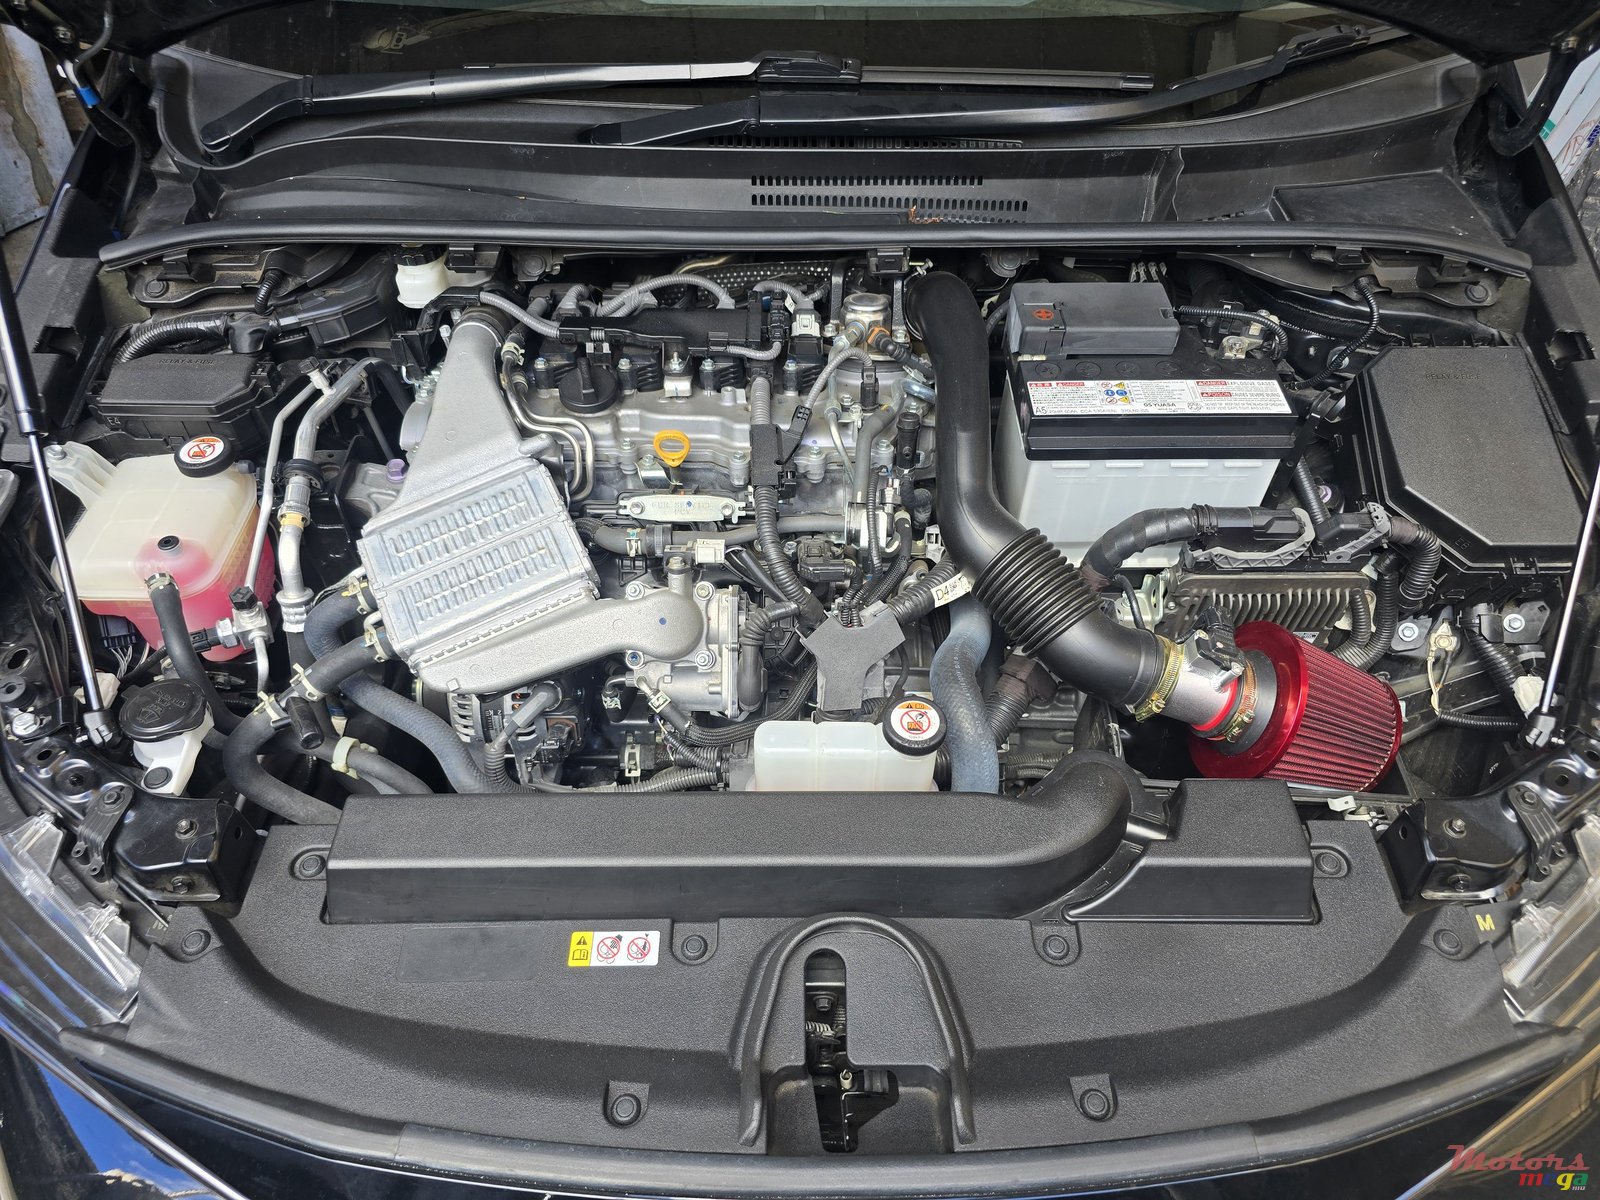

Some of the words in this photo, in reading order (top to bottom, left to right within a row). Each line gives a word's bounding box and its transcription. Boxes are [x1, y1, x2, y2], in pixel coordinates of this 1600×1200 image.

[1035, 406, 1047, 415] A5
[935, 585, 950, 601] D4
[1475, 913, 1496, 931] M
